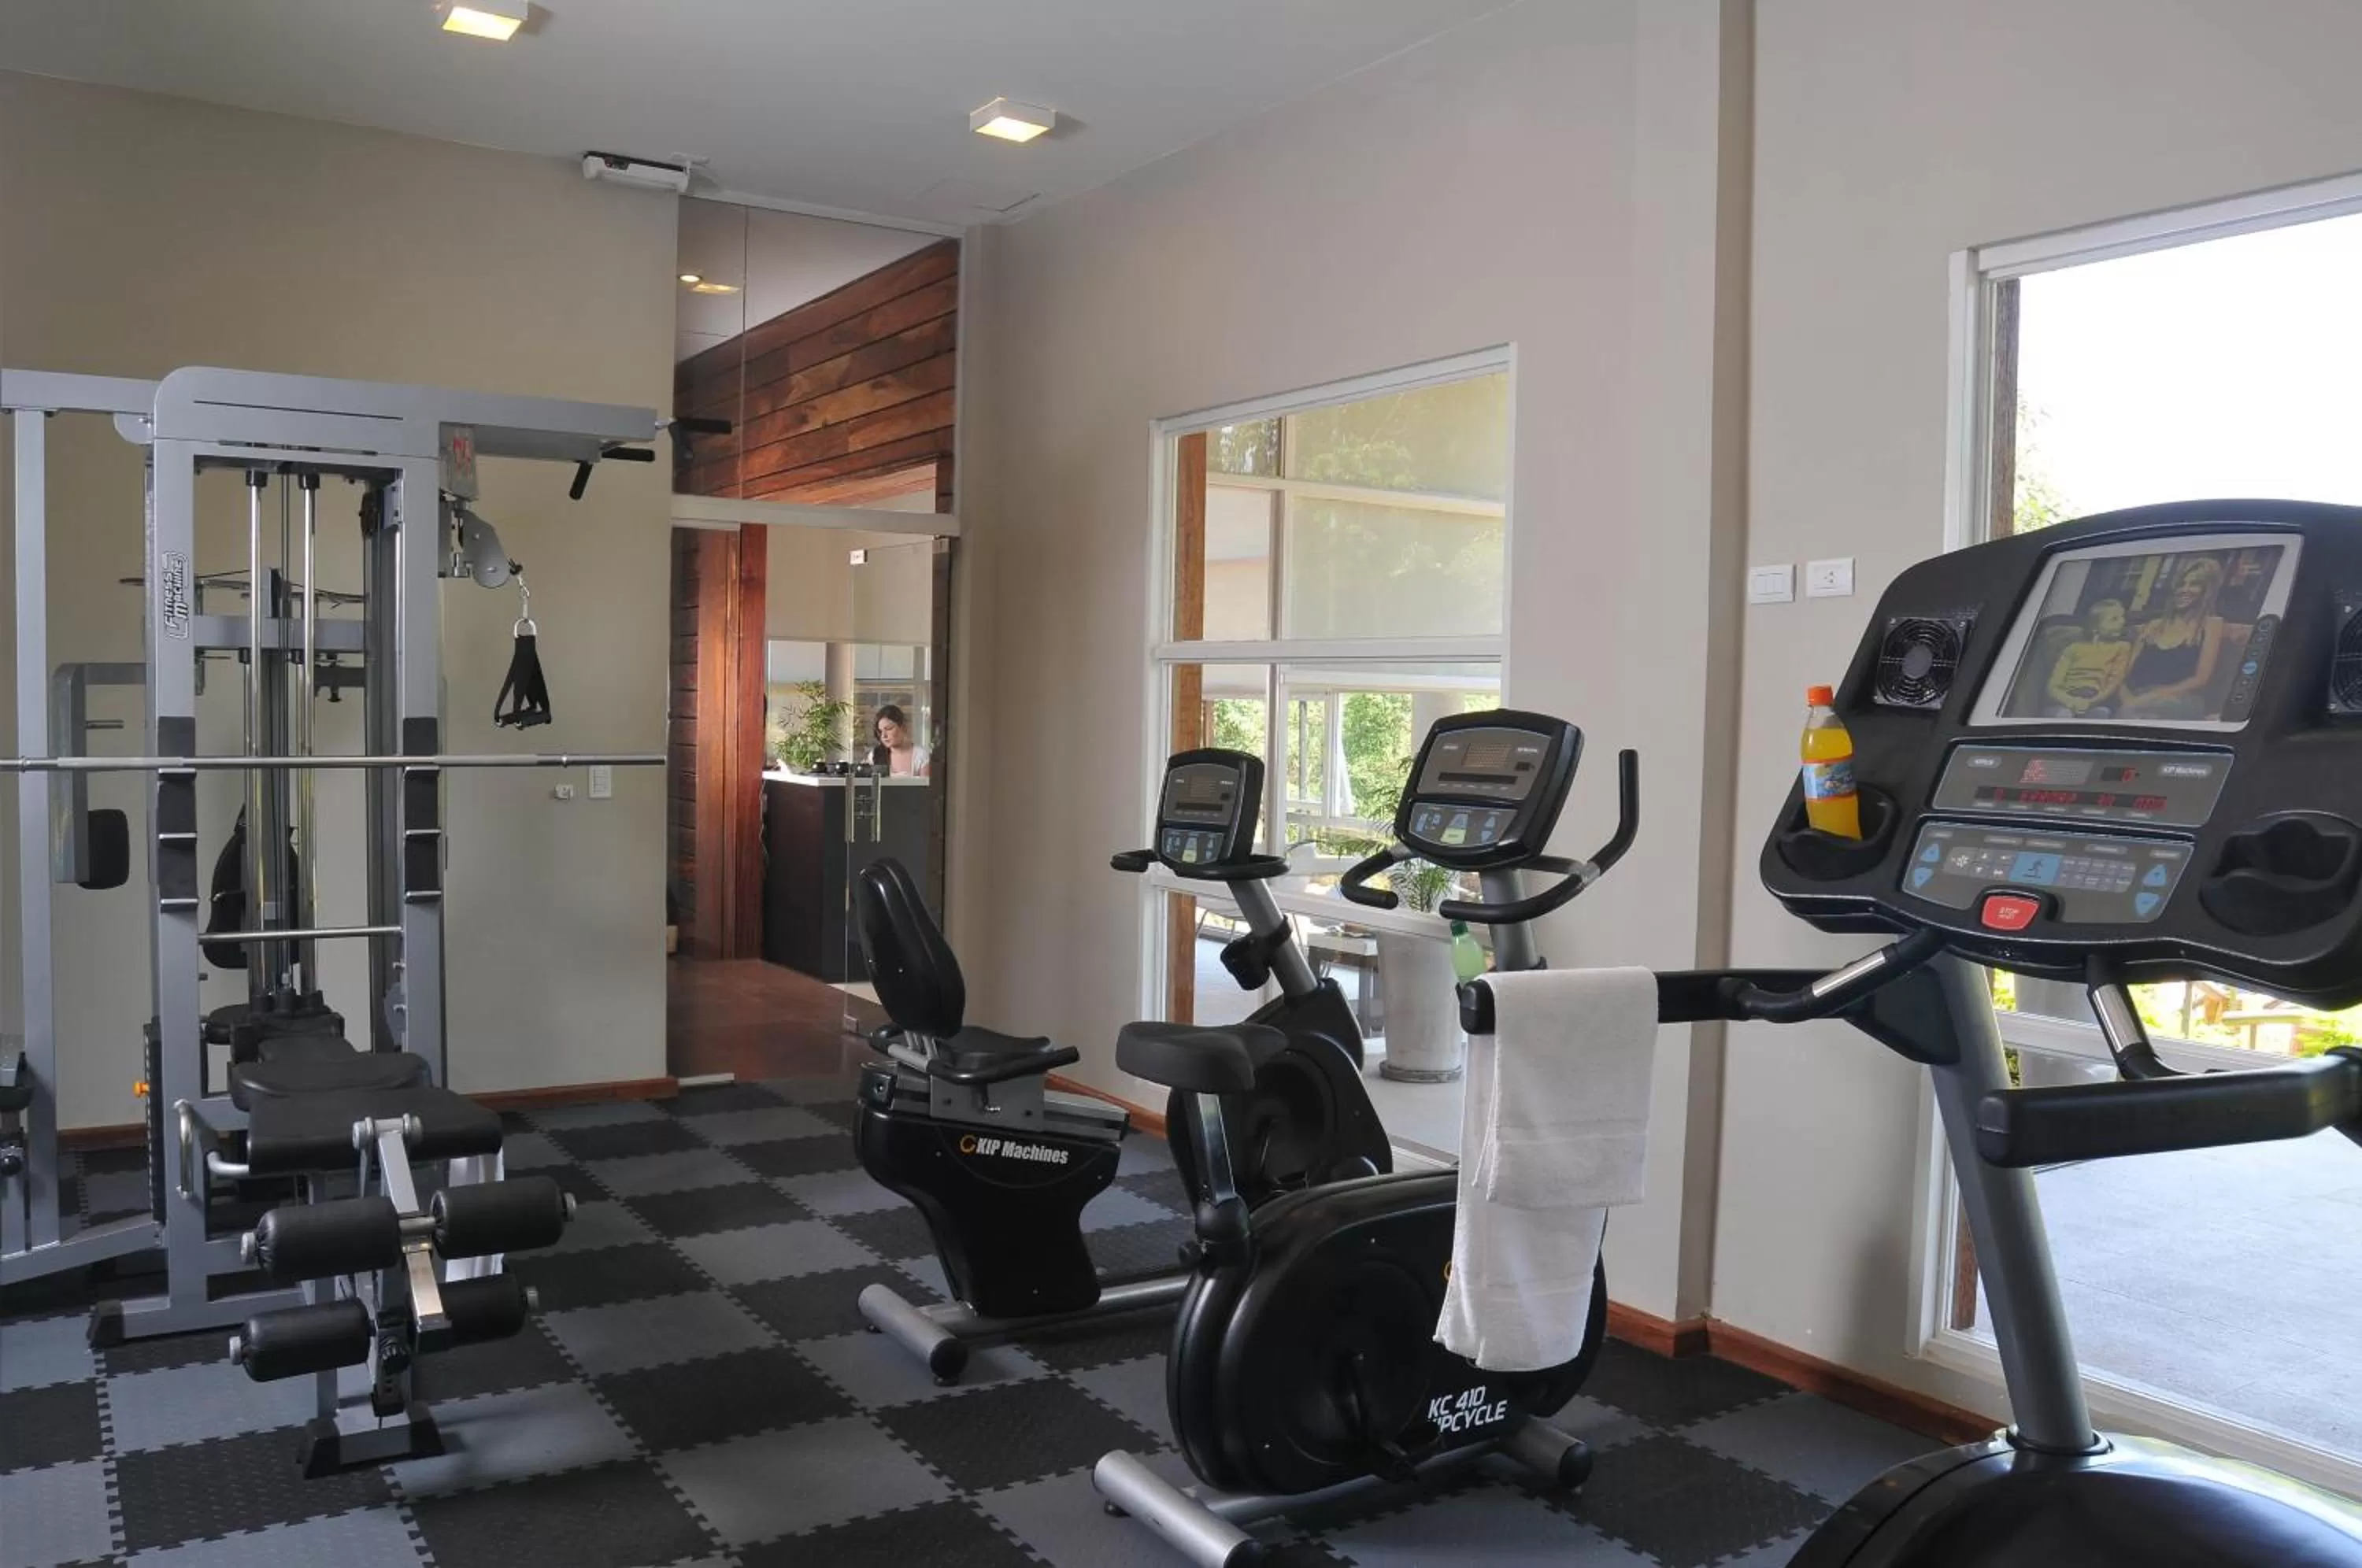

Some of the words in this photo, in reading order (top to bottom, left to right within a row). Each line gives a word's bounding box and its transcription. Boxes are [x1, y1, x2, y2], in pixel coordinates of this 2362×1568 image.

[976, 1137, 1001, 1156] KIP
[1001, 1141, 1068, 1164] Machines
[1426, 1400, 1508, 1433] PCYCLE
[1427, 1394, 1453, 1419] KC
[1455, 1385, 1486, 1410] 410
